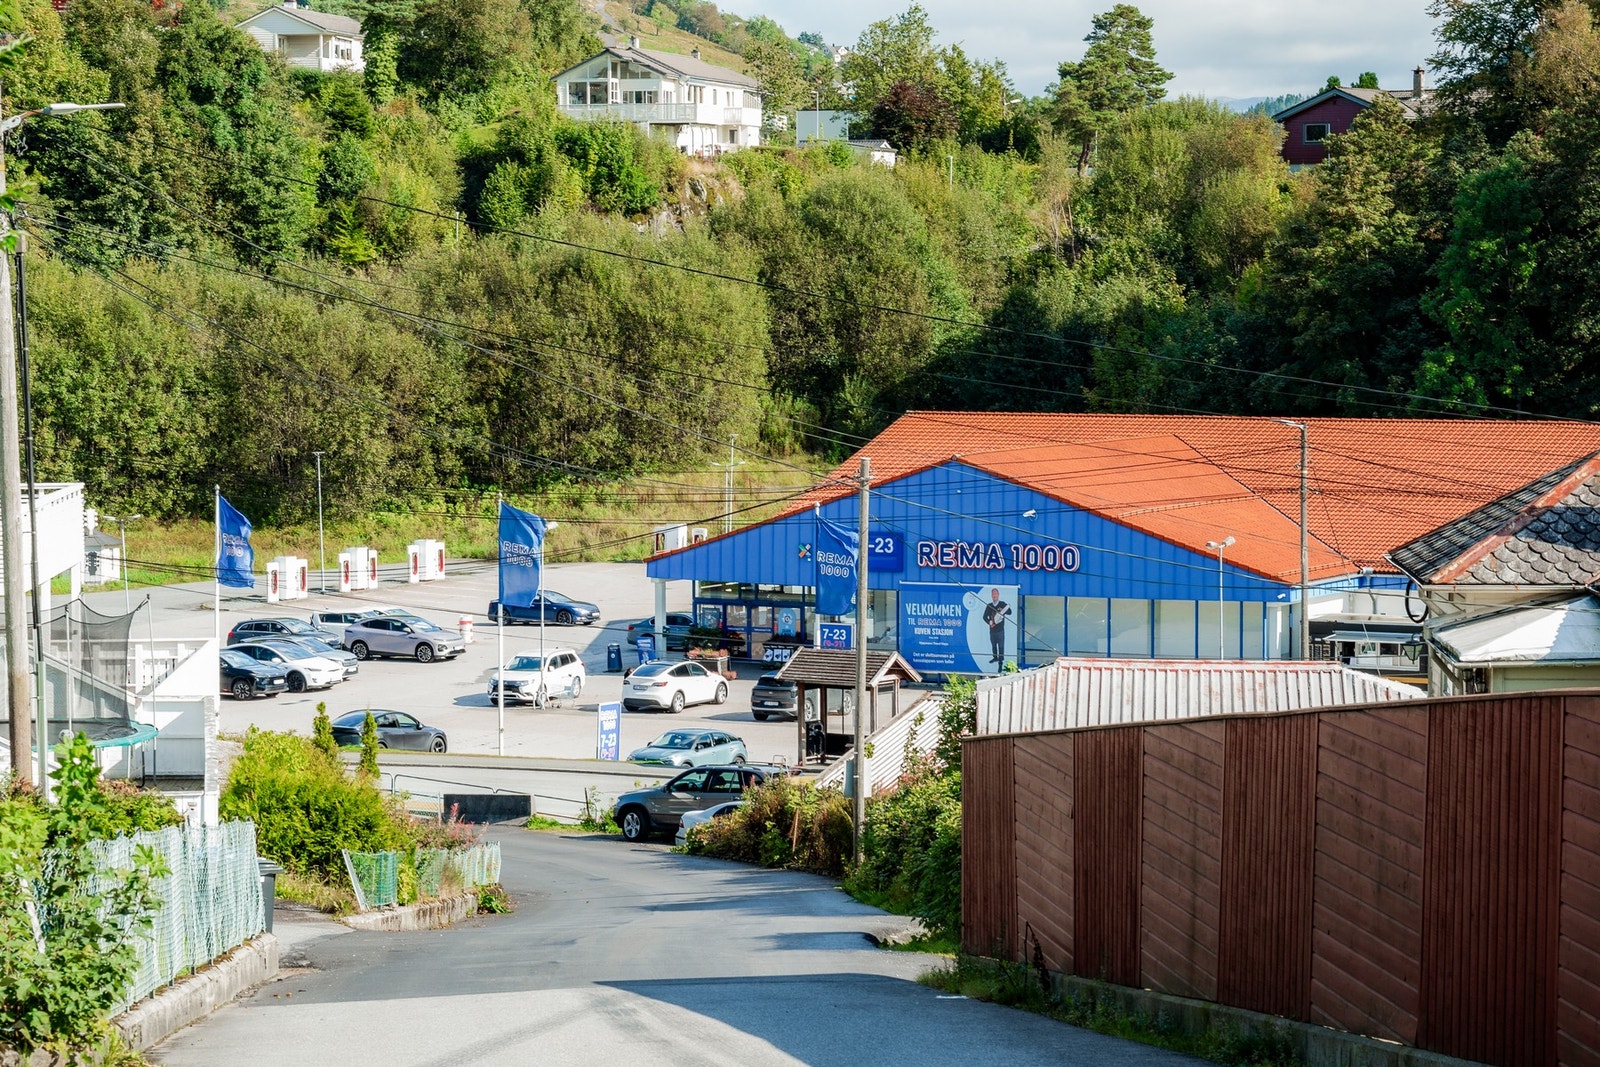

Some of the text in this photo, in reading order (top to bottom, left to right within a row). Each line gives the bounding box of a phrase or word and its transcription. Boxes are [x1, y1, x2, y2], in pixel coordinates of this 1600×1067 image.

[502, 540, 537, 557] REMA
[868, 537, 894, 554] -23
[816, 550, 855, 567] REMA
[917, 540, 1080, 573] REMA 1000
[820, 563, 850, 578] 1000
[905, 602, 962, 617] VELKOMMEN
[908, 617, 916, 626] TIL
[822, 628, 847, 641] 7-23
